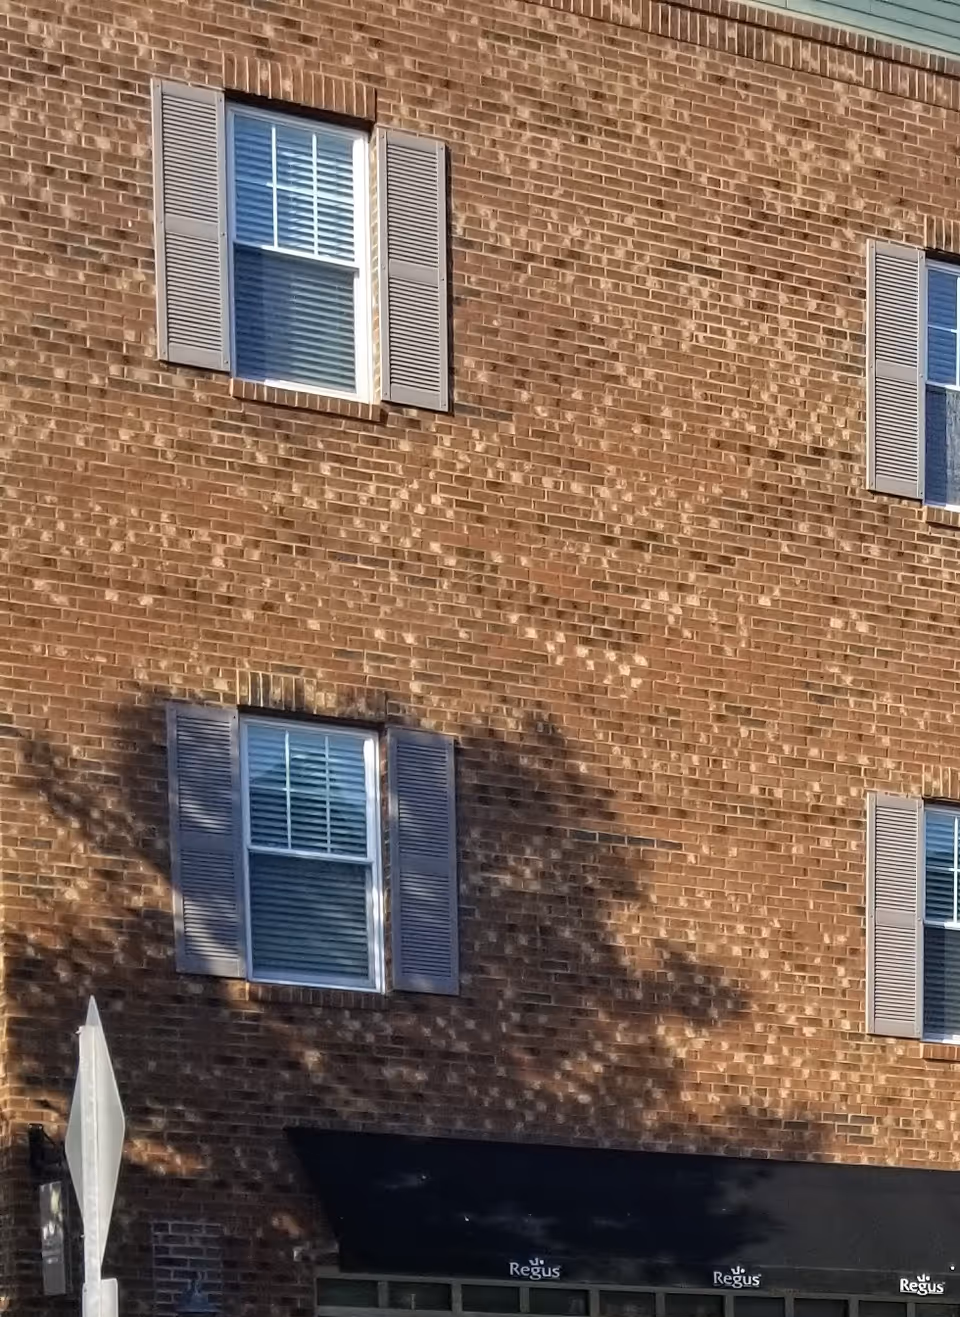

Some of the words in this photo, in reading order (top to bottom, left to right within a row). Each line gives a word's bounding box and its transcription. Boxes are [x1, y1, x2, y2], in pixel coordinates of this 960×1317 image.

[509, 1261, 561, 1281] Regus
[713, 1271, 760, 1289] Regus
[899, 1277, 944, 1296] Regus
